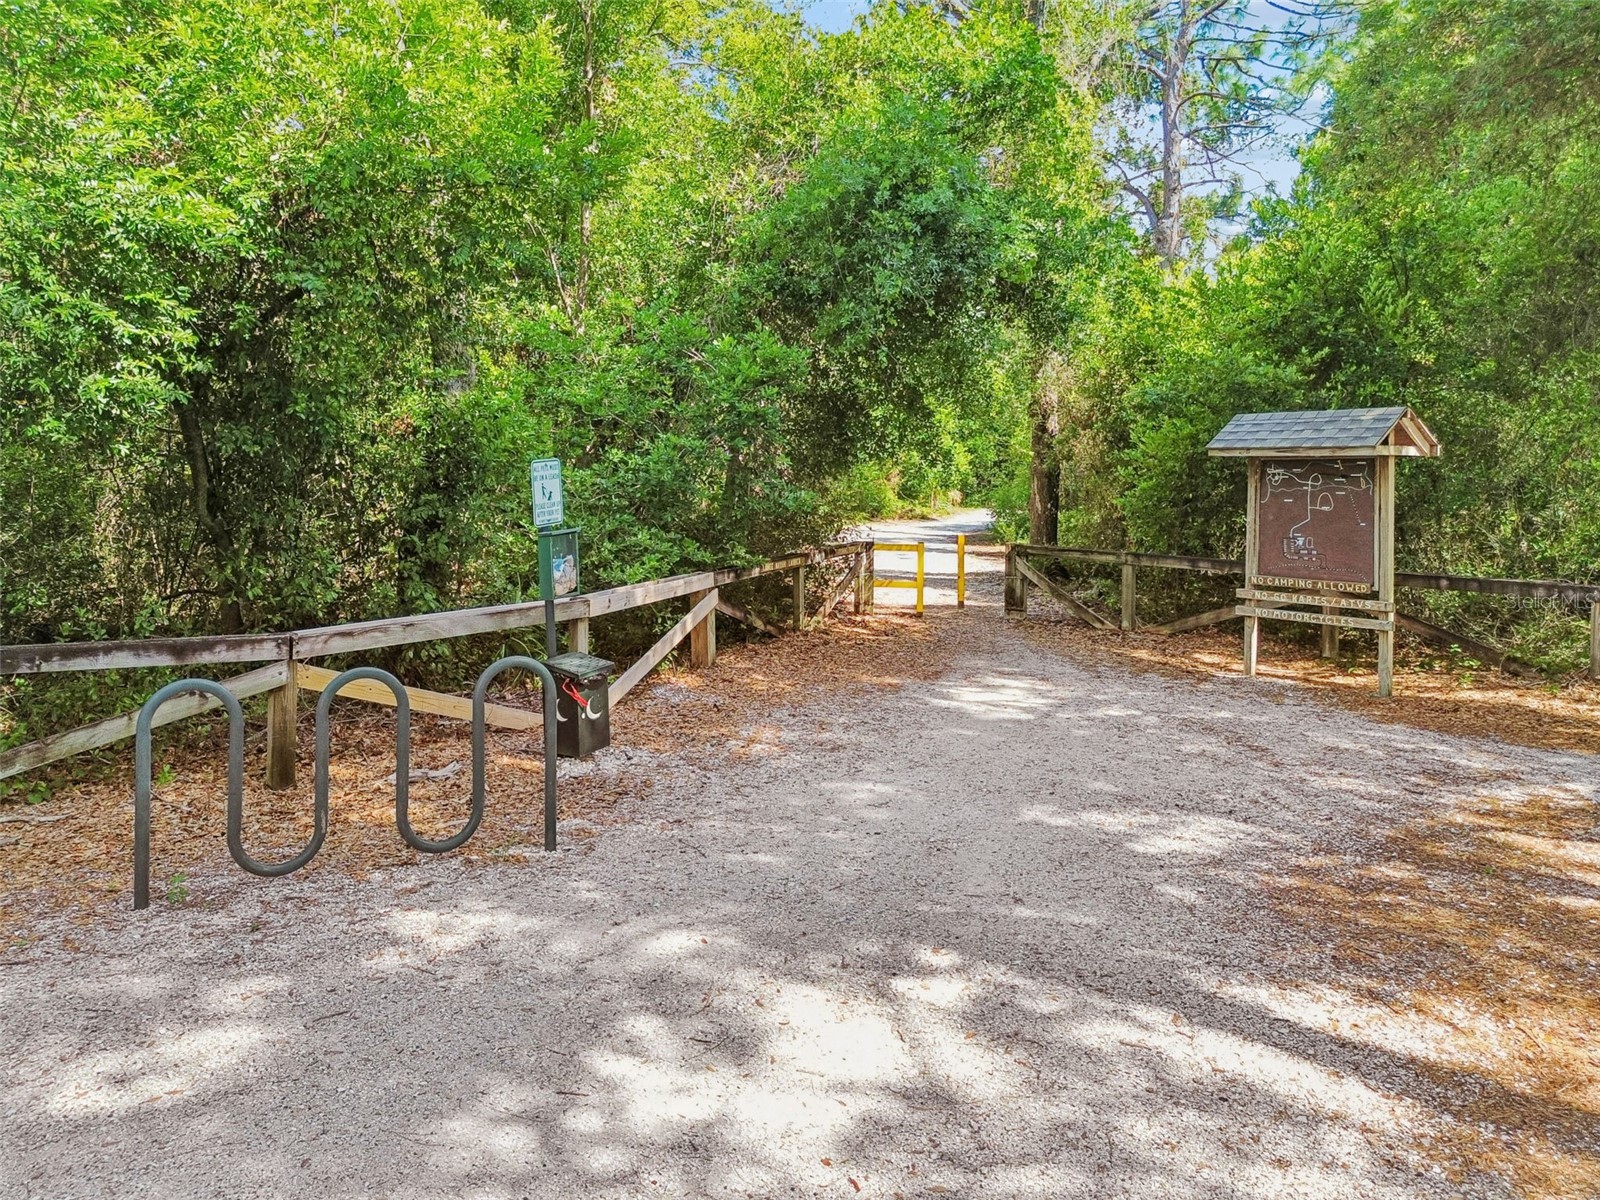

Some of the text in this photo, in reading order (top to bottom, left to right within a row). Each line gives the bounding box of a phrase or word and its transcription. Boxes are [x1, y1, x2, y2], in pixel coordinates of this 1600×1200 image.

[1251, 575, 1367, 593] NO CAMPING ALLOWED
[1255, 591, 1267, 600] NO
[1255, 608, 1354, 626] NO MOTORCYCLES
